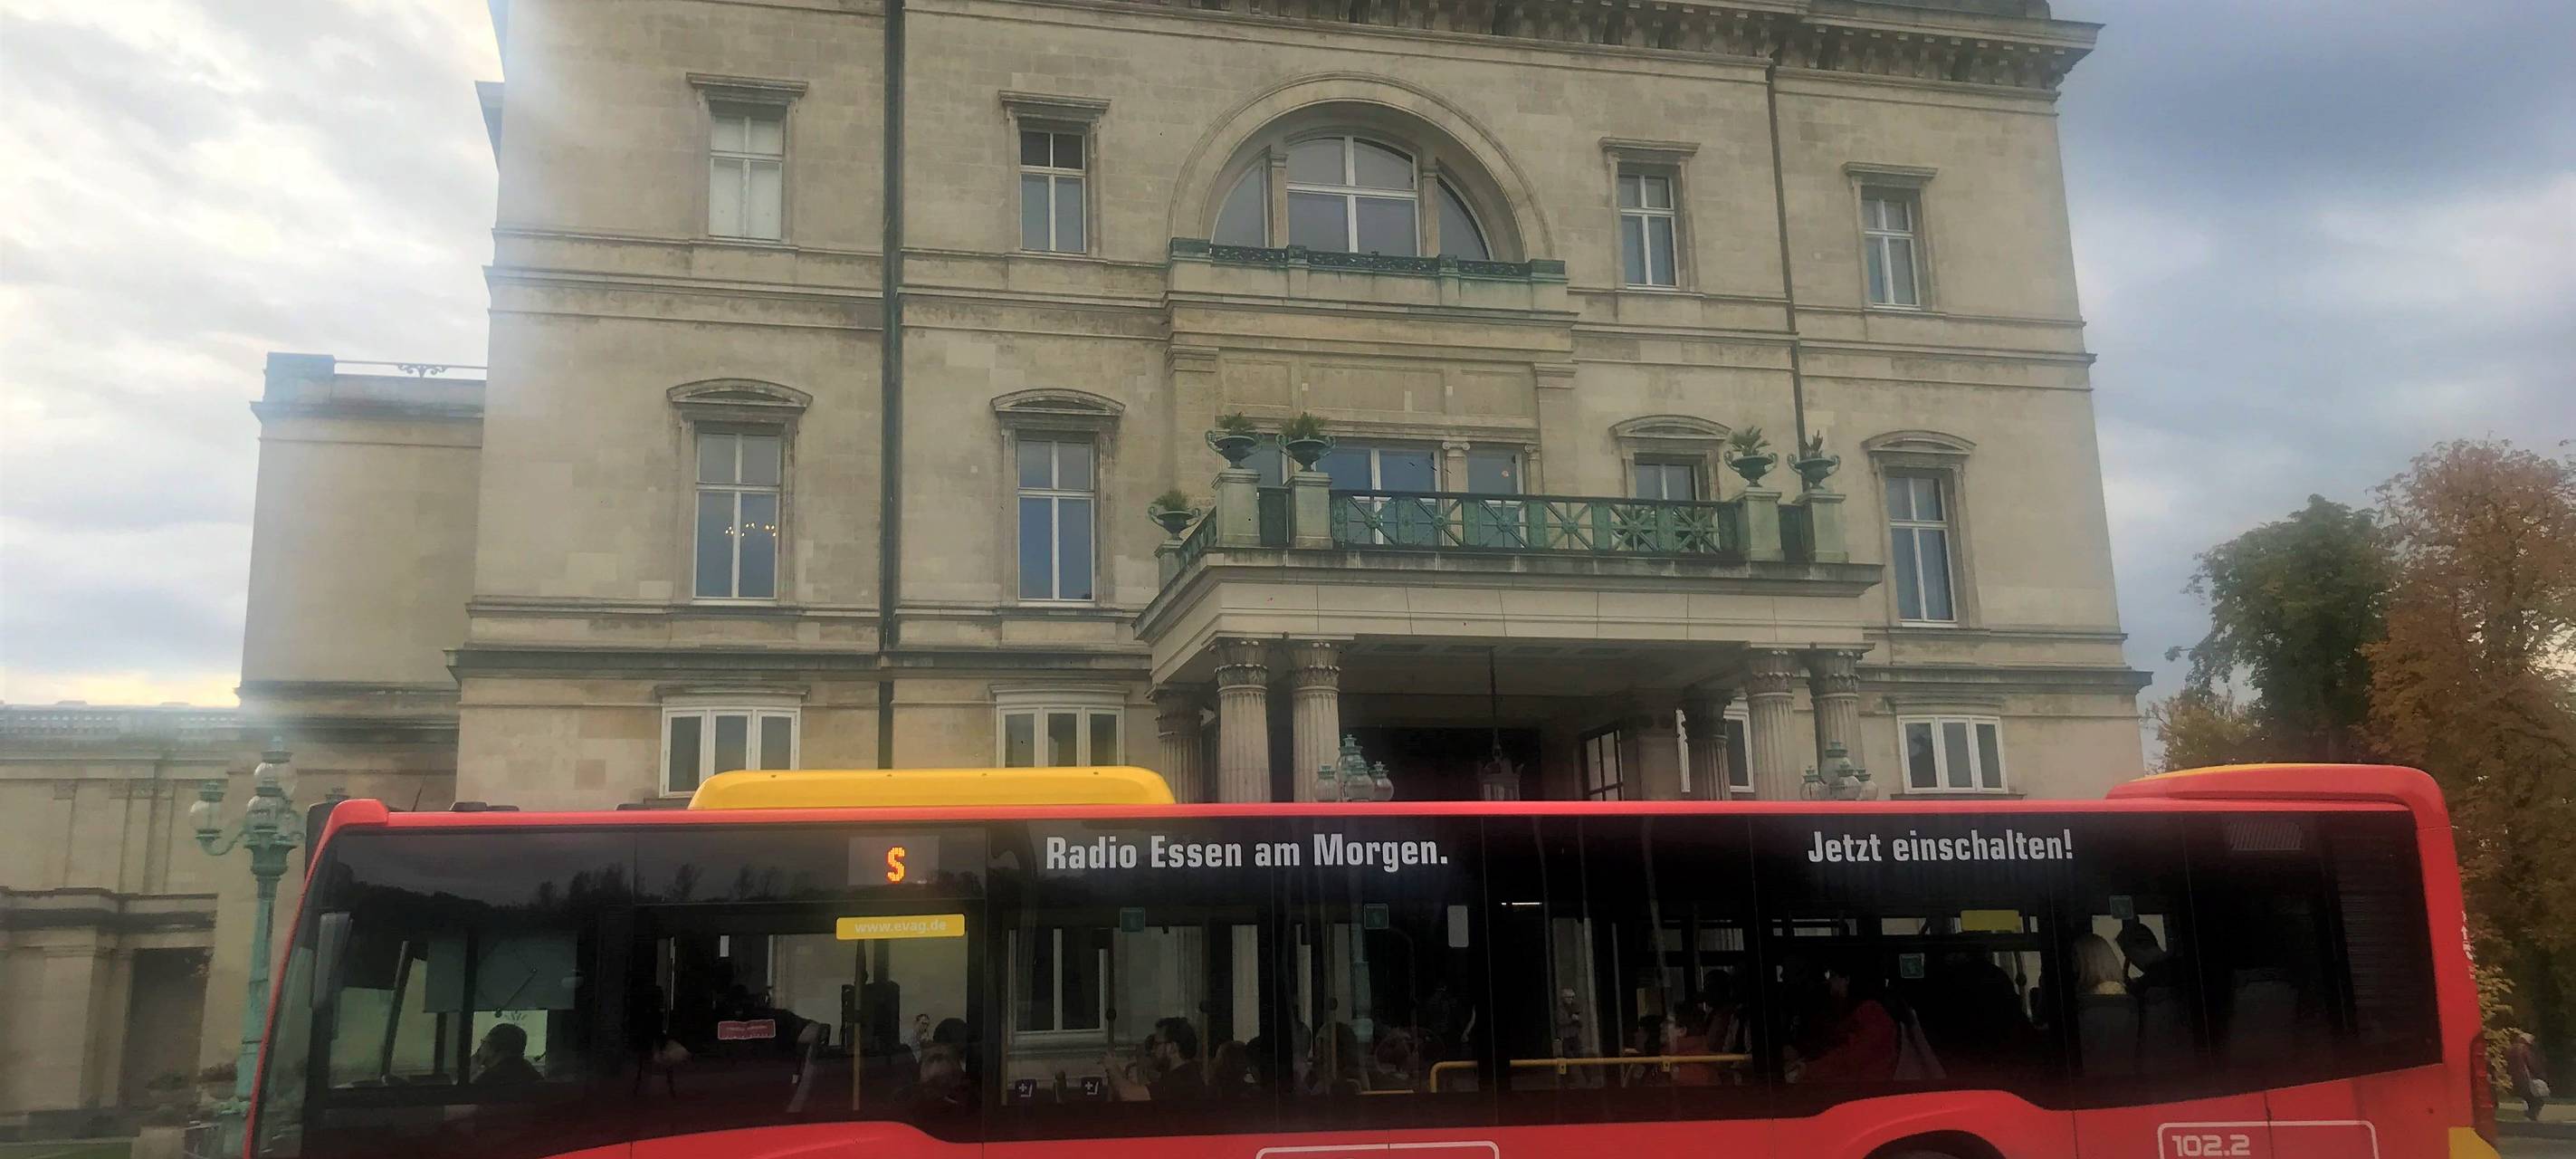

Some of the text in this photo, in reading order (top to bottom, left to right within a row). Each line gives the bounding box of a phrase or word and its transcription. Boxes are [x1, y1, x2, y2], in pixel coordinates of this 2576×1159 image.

[1046, 833, 1448, 873] Radio Essen am Morgen.
[1808, 829, 2073, 862] Jetzt einschalten!
[887, 847, 905, 882] S
[854, 919, 947, 934] www.evag.de
[2171, 1134, 2251, 1157] 102.2
